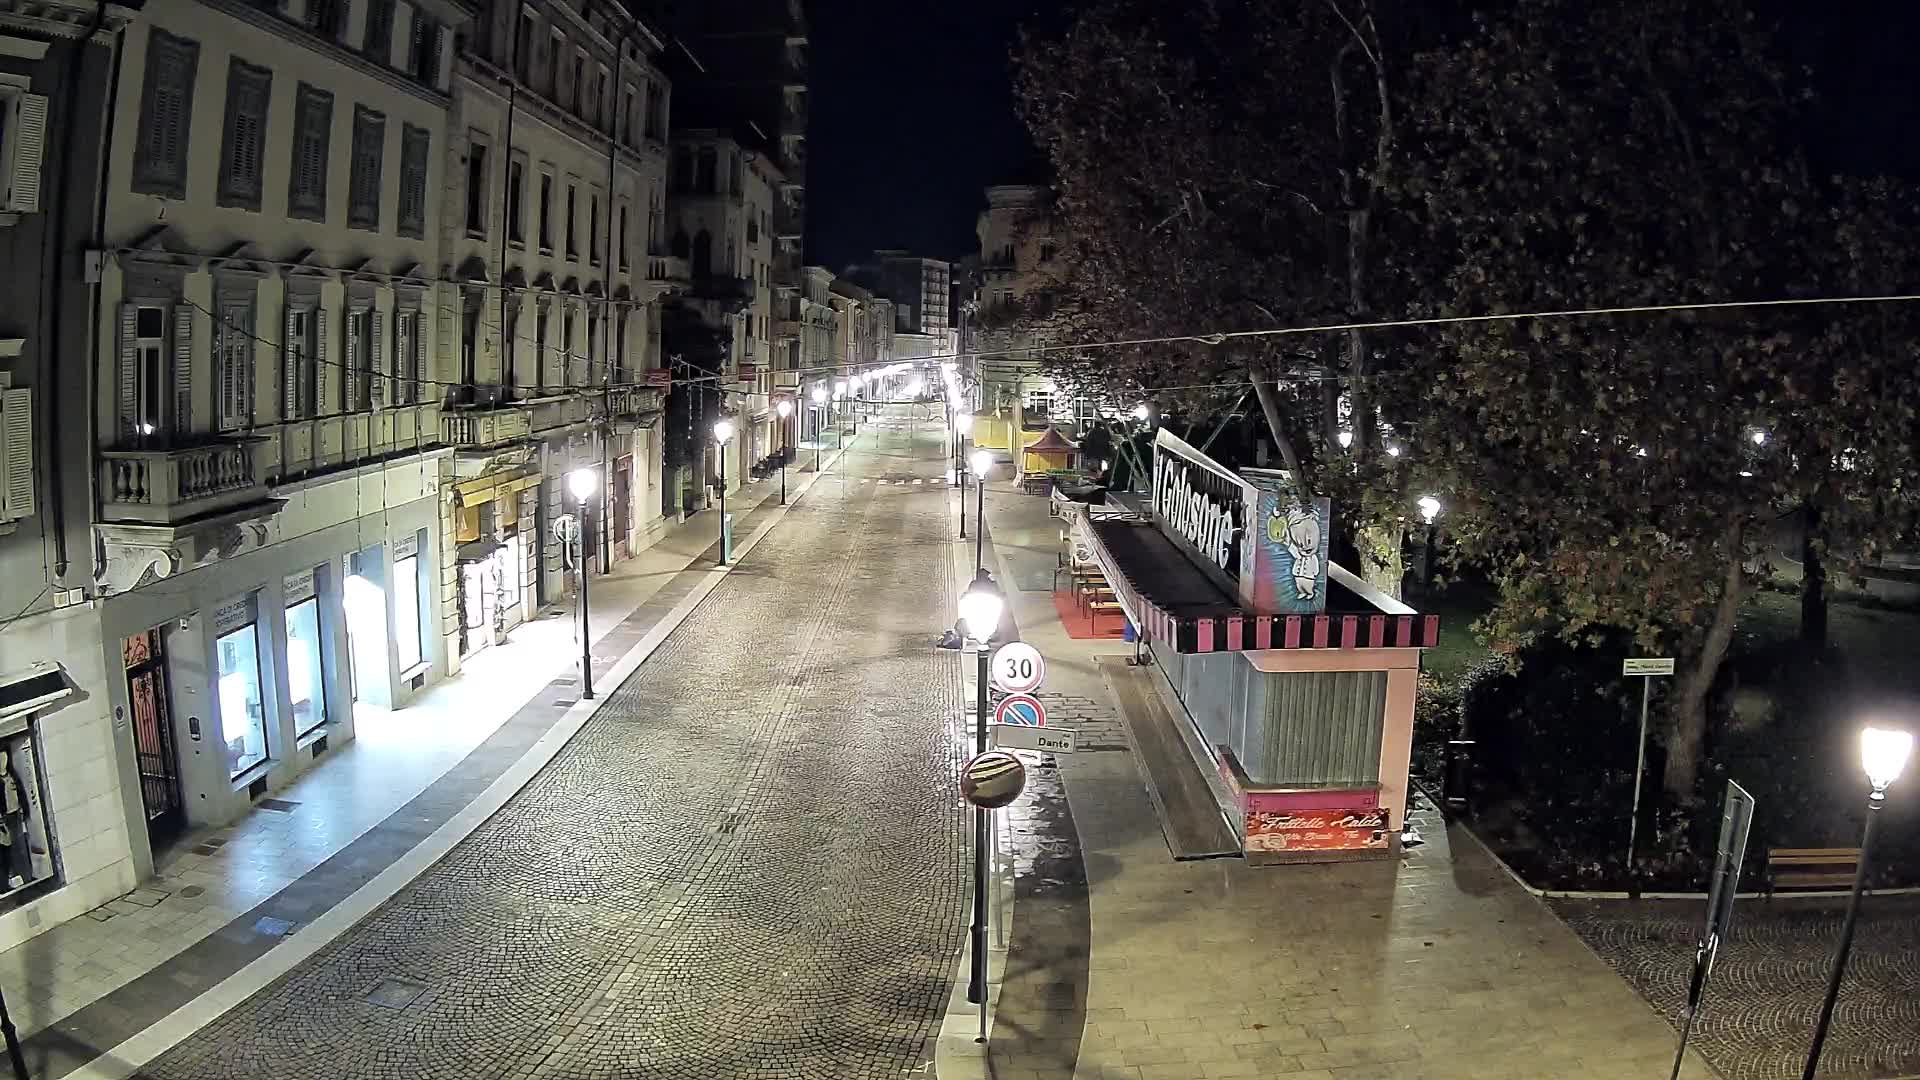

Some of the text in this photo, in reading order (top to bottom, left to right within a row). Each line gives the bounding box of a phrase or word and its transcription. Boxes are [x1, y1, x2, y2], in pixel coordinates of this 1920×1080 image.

[1163, 458, 1233, 570] Golosone
[1006, 658, 1032, 679] 30
[1038, 737, 1070, 749] Dante
